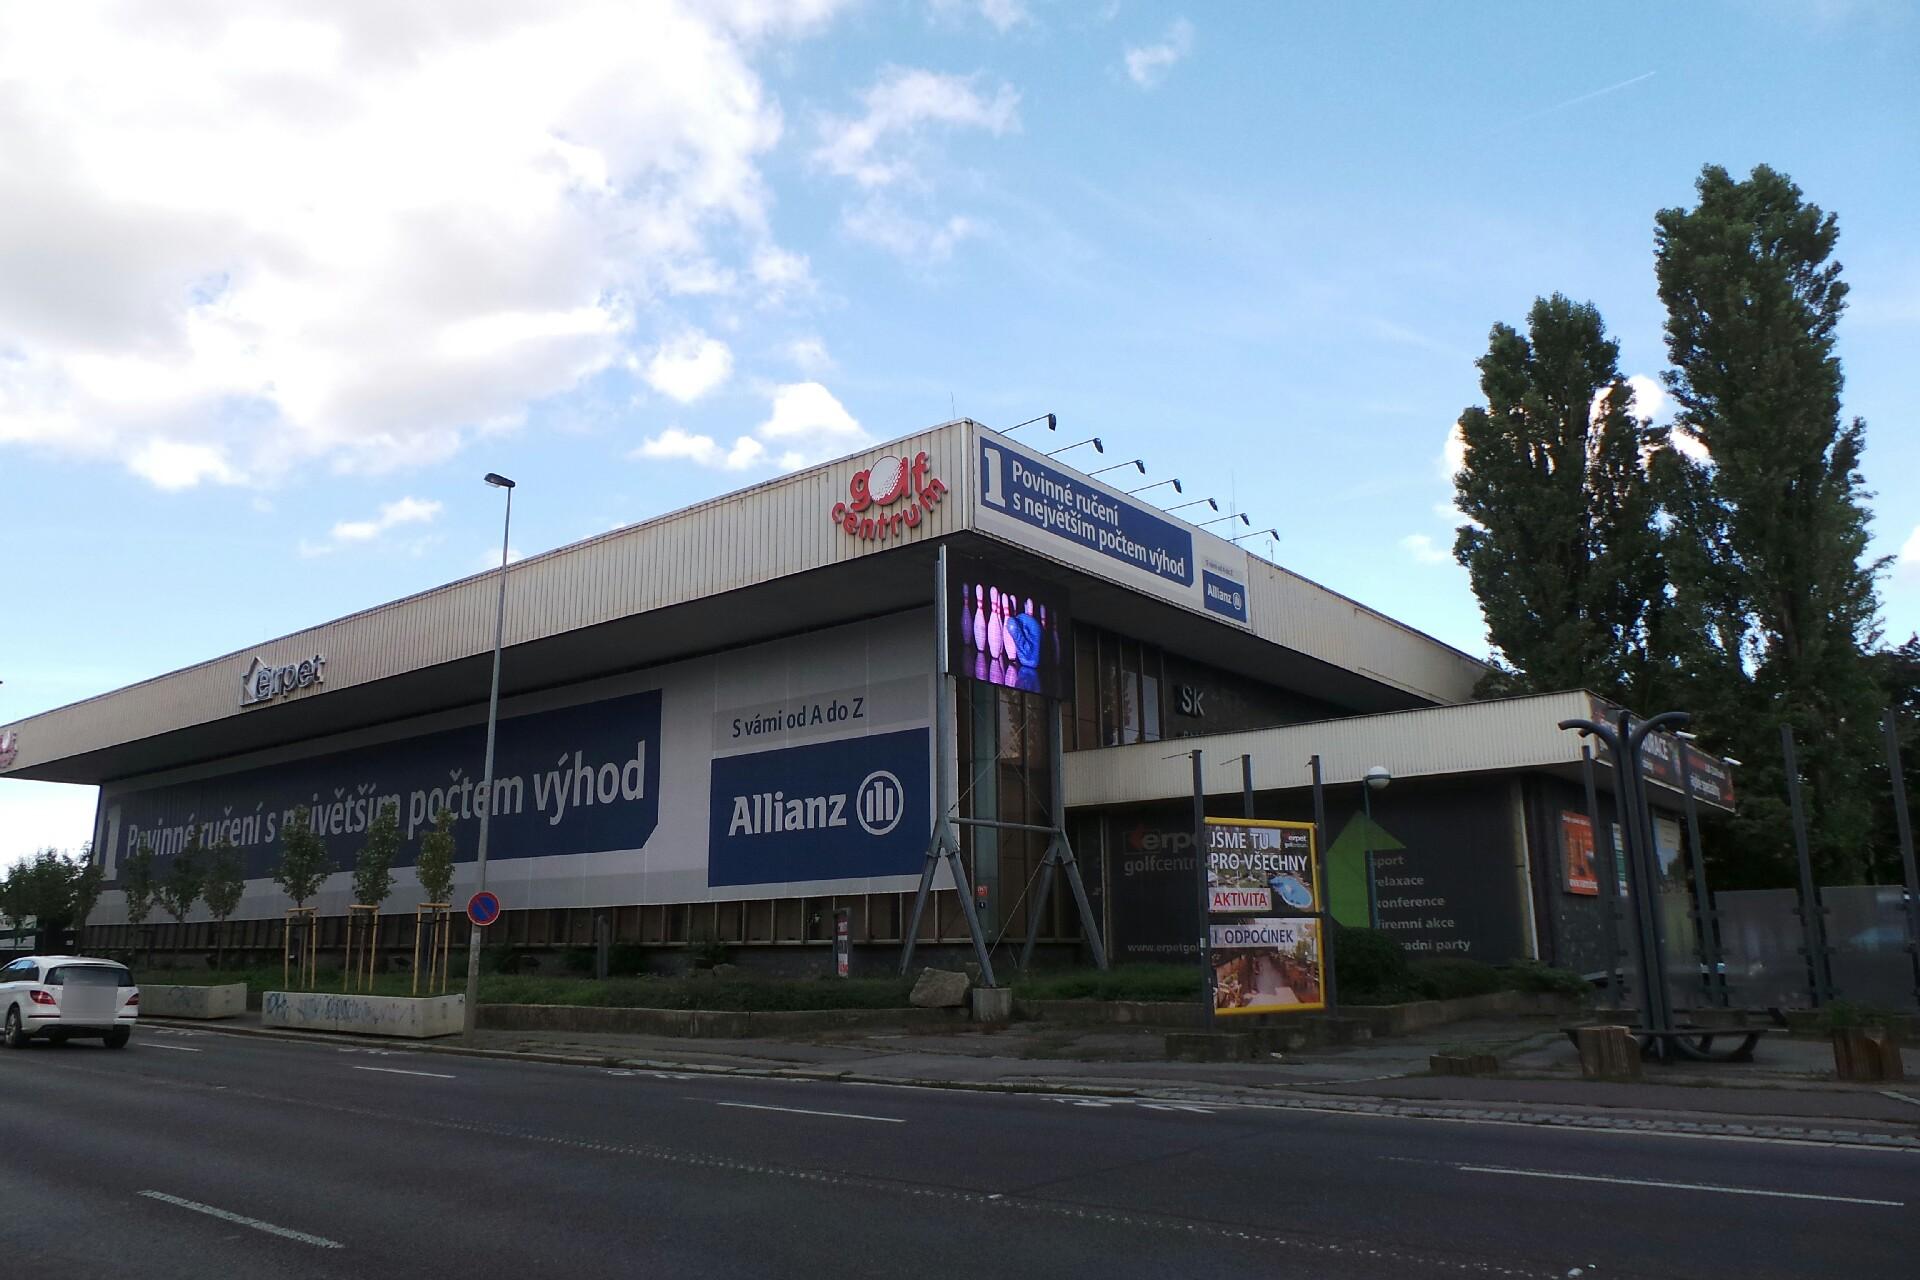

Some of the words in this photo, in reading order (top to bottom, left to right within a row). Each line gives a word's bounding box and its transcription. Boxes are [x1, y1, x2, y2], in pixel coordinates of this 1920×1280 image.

[850, 451, 929, 512] golf
[984, 447, 1006, 509] 1
[1012, 459, 1073, 507] Povinné
[1076, 494, 1119, 528] ručení
[832, 478, 948, 541] centrum
[1013, 491, 1021, 510] s
[1024, 495, 1096, 543] největším
[1099, 528, 1148, 565] počtem
[1149, 547, 1185, 578] výhod
[1207, 583, 1233, 604] Allianz
[732, 718, 741, 738] S
[745, 710, 782, 736] vámi
[787, 705, 806, 729] od
[810, 704, 823, 726] A
[827, 700, 848, 722] do
[852, 697, 864, 718] Z
[1181, 686, 1205, 716] SK
[263, 811, 277, 843] s
[407, 767, 525, 841] počtem
[533, 739, 646, 827] výhod
[728, 790, 848, 837] Allianz
[1210, 831, 1247, 849] JSME
[1250, 832, 1269, 849] TU
[1210, 852, 1240, 870] PRO
[1243, 851, 1308, 871] VŠECHNY
[1214, 892, 1268, 907] AKTIVITA
[1214, 931, 1218, 943] I
[1225, 927, 1294, 943] ODPOČINEK
[1425, 918, 1455, 928] akce
[1436, 939, 1471, 953] party
